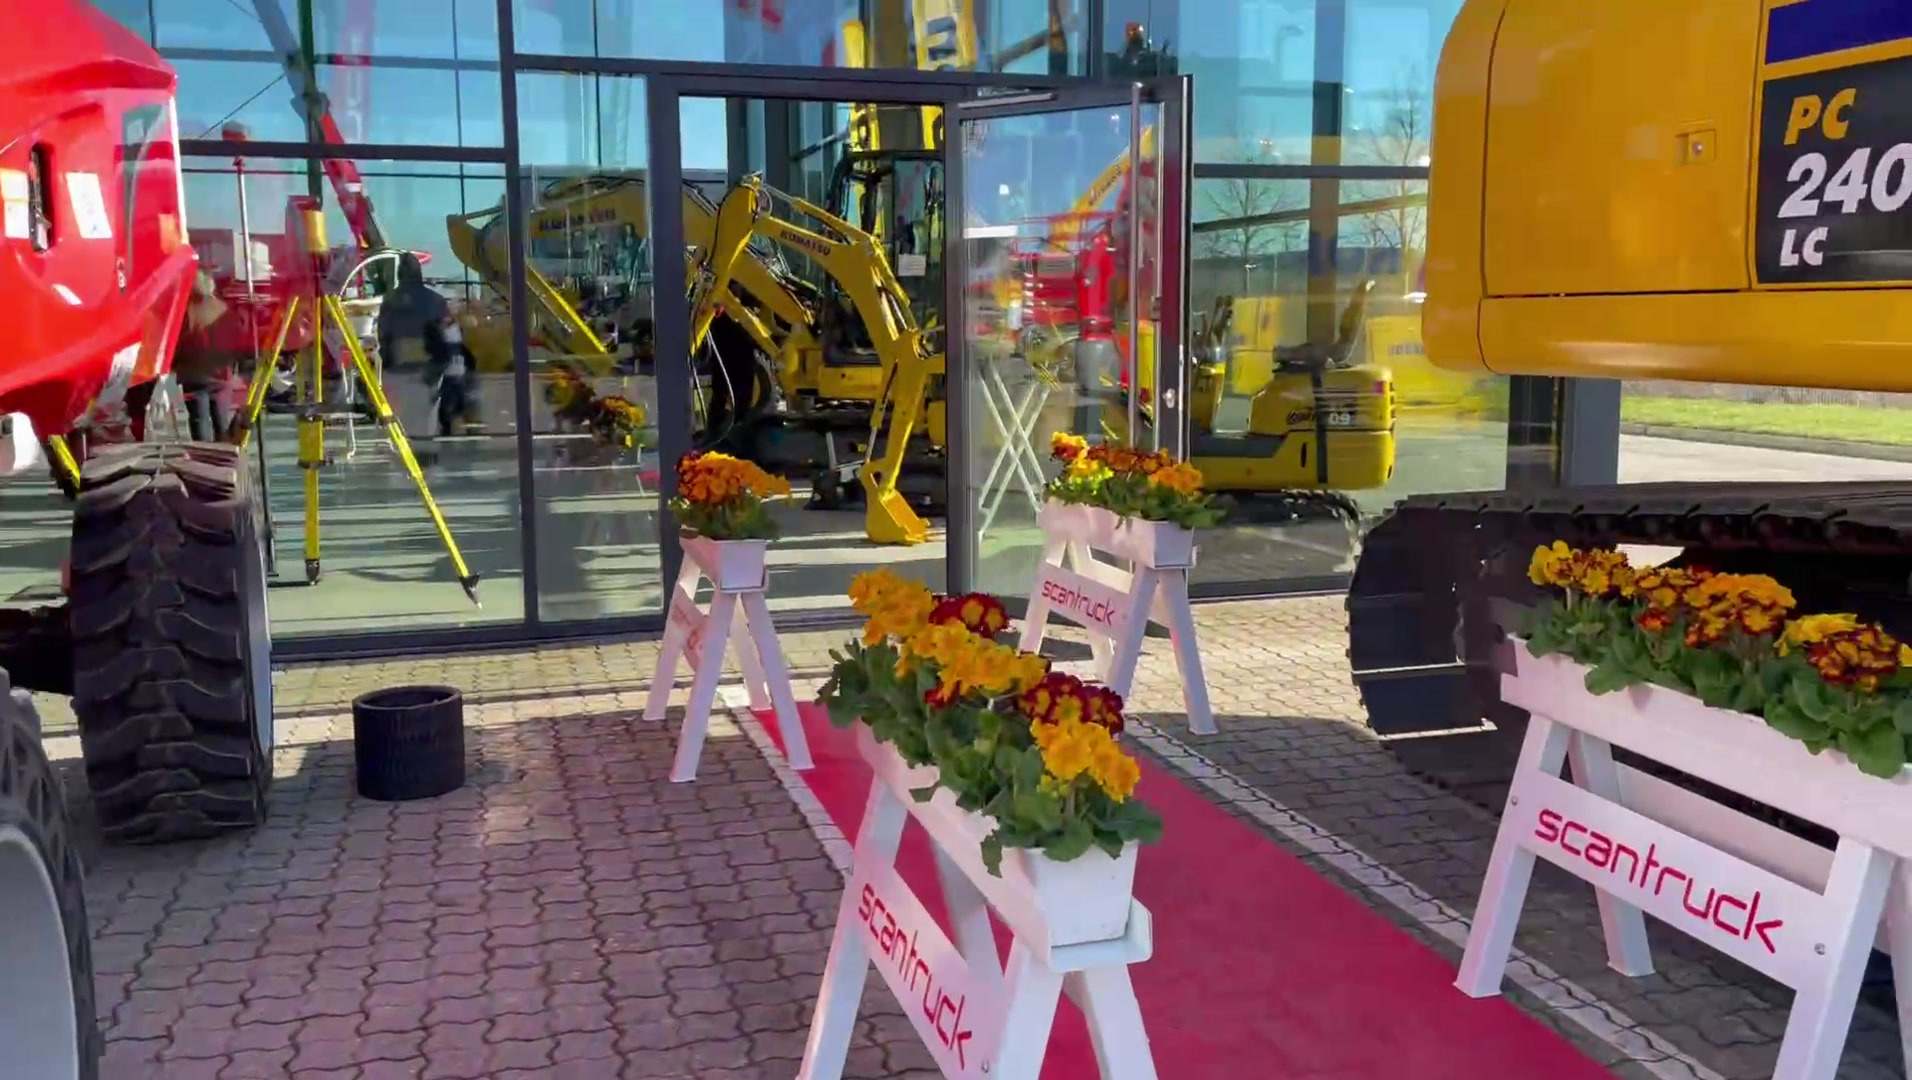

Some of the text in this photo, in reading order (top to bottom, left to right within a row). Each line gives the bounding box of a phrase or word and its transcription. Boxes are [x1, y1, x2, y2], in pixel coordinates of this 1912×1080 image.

[1783, 87, 1857, 146] PC
[1777, 142, 1912, 218] 240
[1779, 226, 1829, 267] LC
[1041, 580, 1115, 627] scantruck
[1534, 808, 1783, 954] scantruck
[858, 883, 973, 1071] scantruck
